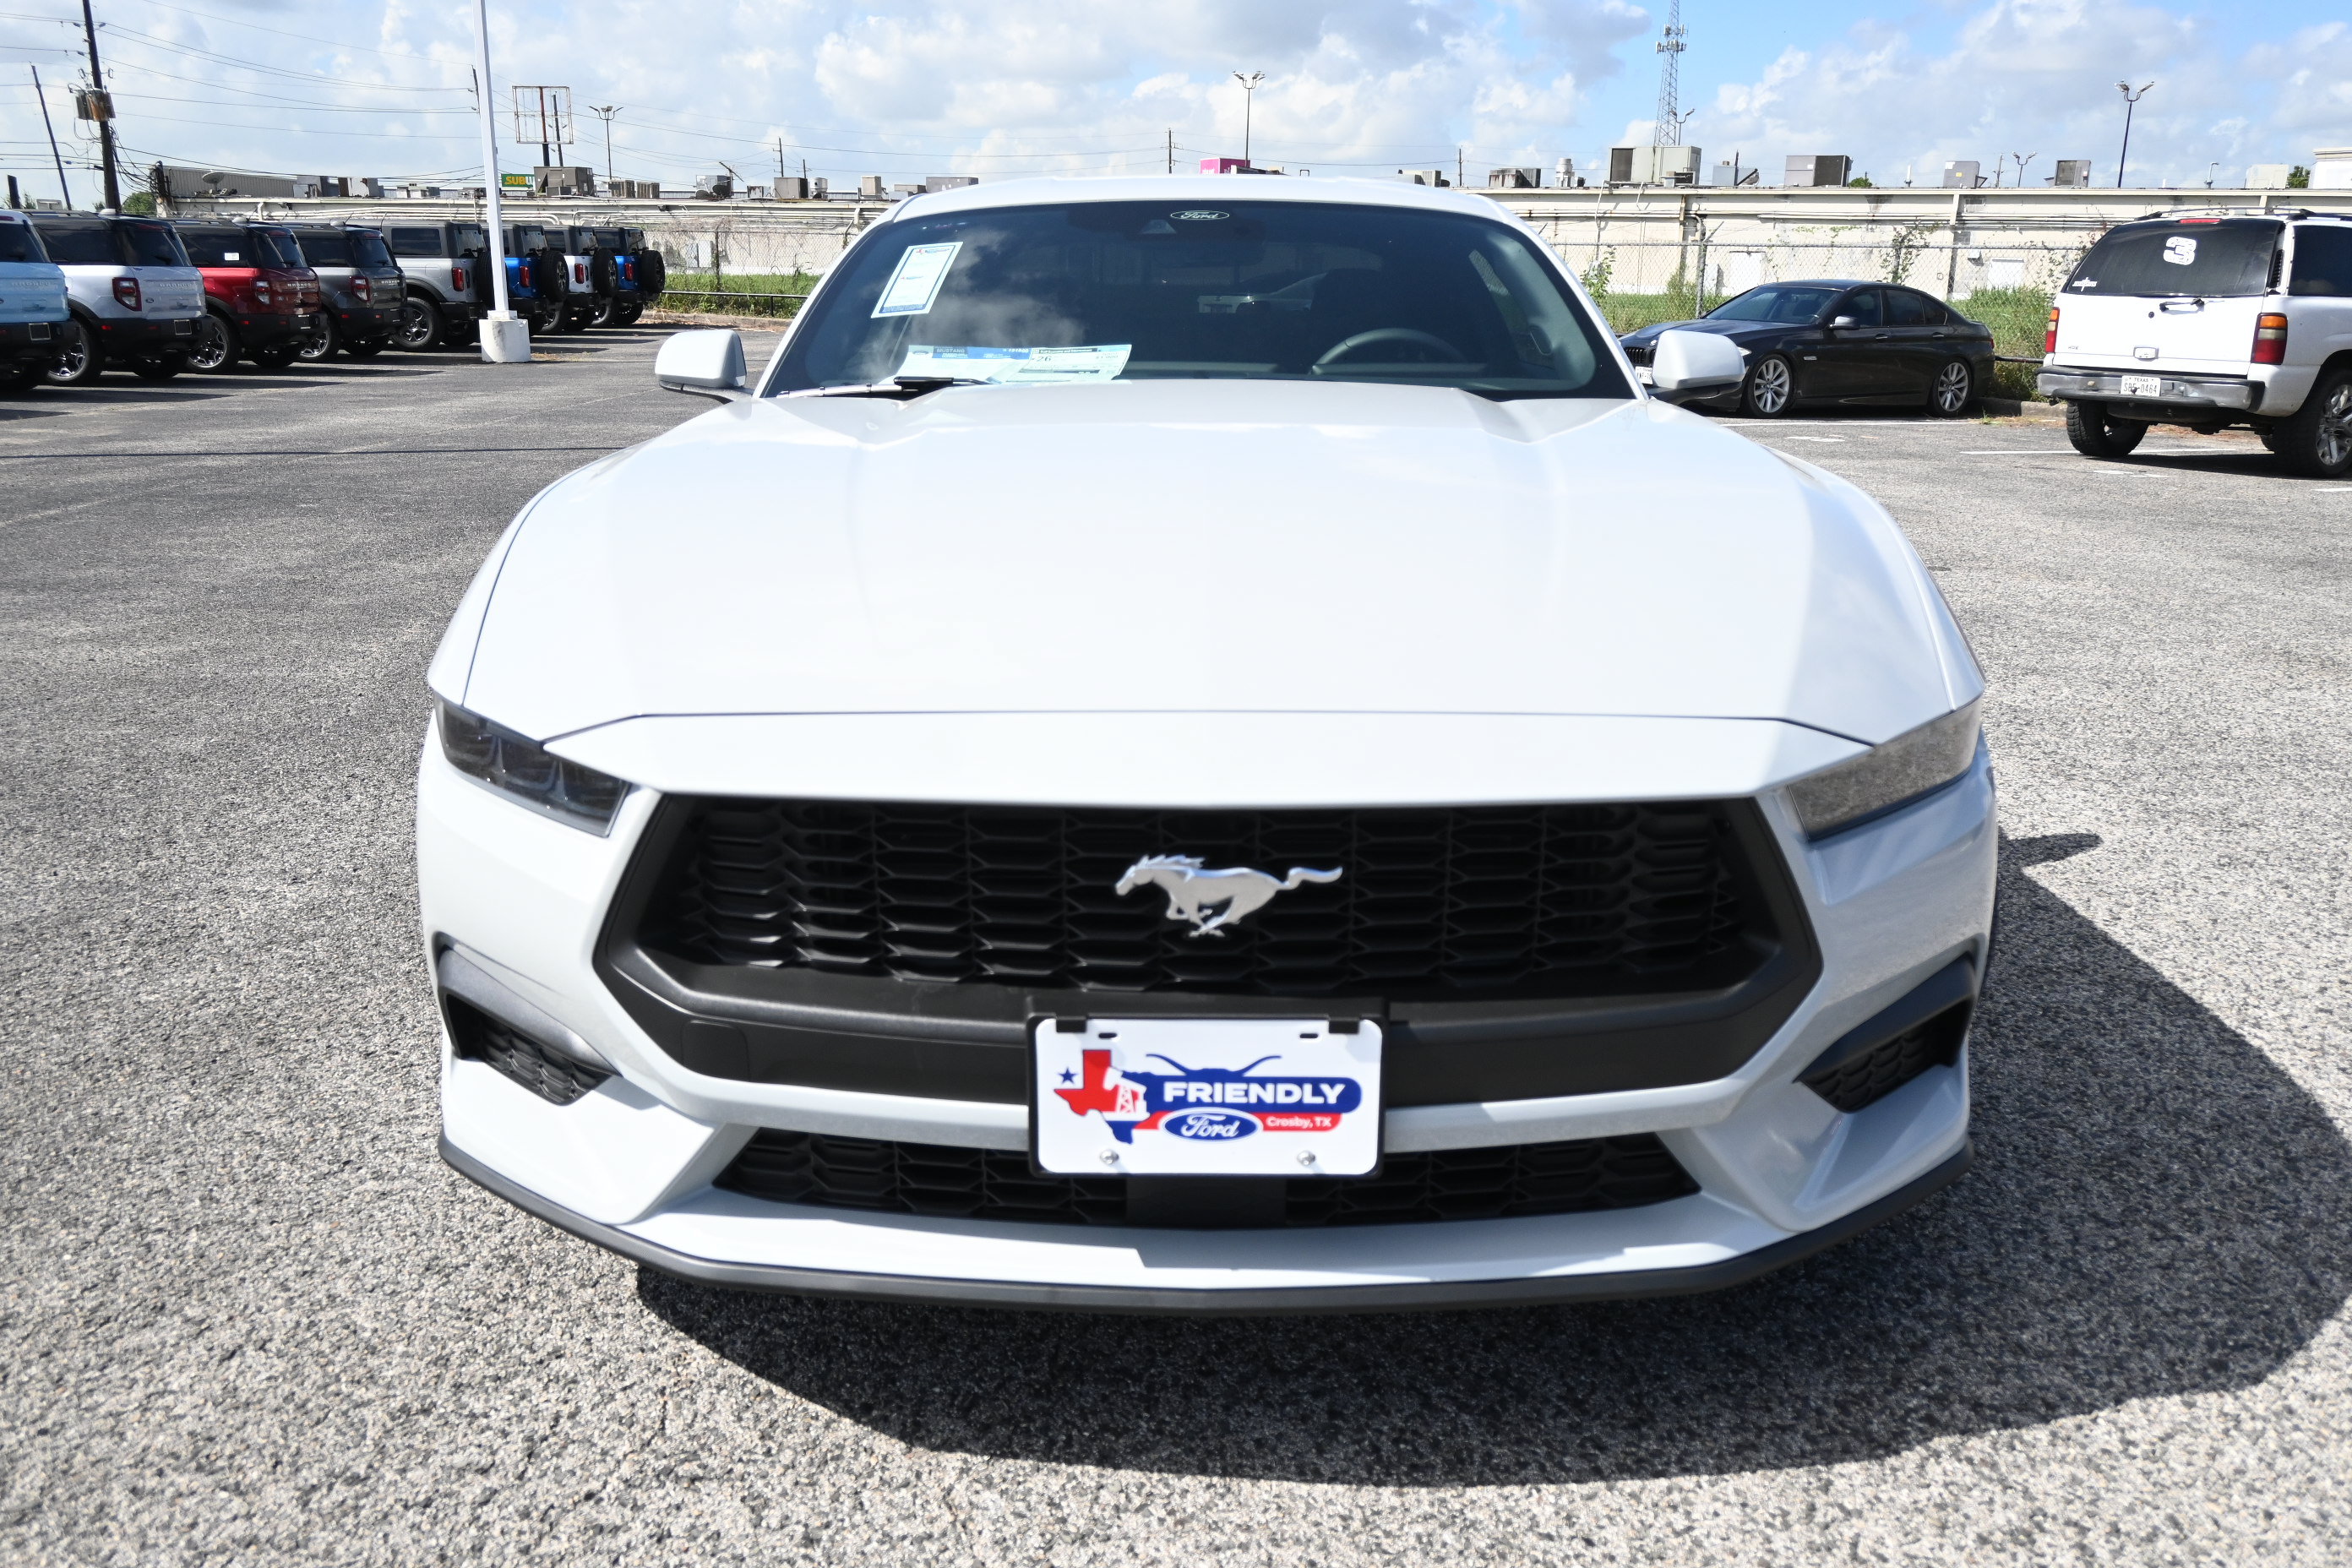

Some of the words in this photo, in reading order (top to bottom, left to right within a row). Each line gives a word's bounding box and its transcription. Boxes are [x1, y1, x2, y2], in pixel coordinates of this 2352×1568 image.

[504, 176, 536, 185] SUBW
[1179, 210, 1220, 220] Ford
[2163, 237, 2197, 265] 3
[1164, 1081, 1346, 1104] FRIENDLY
[1181, 1113, 1241, 1137] Ford
[1266, 1116, 1313, 1129] Crosby,
[1315, 1116, 1332, 1127] TX
